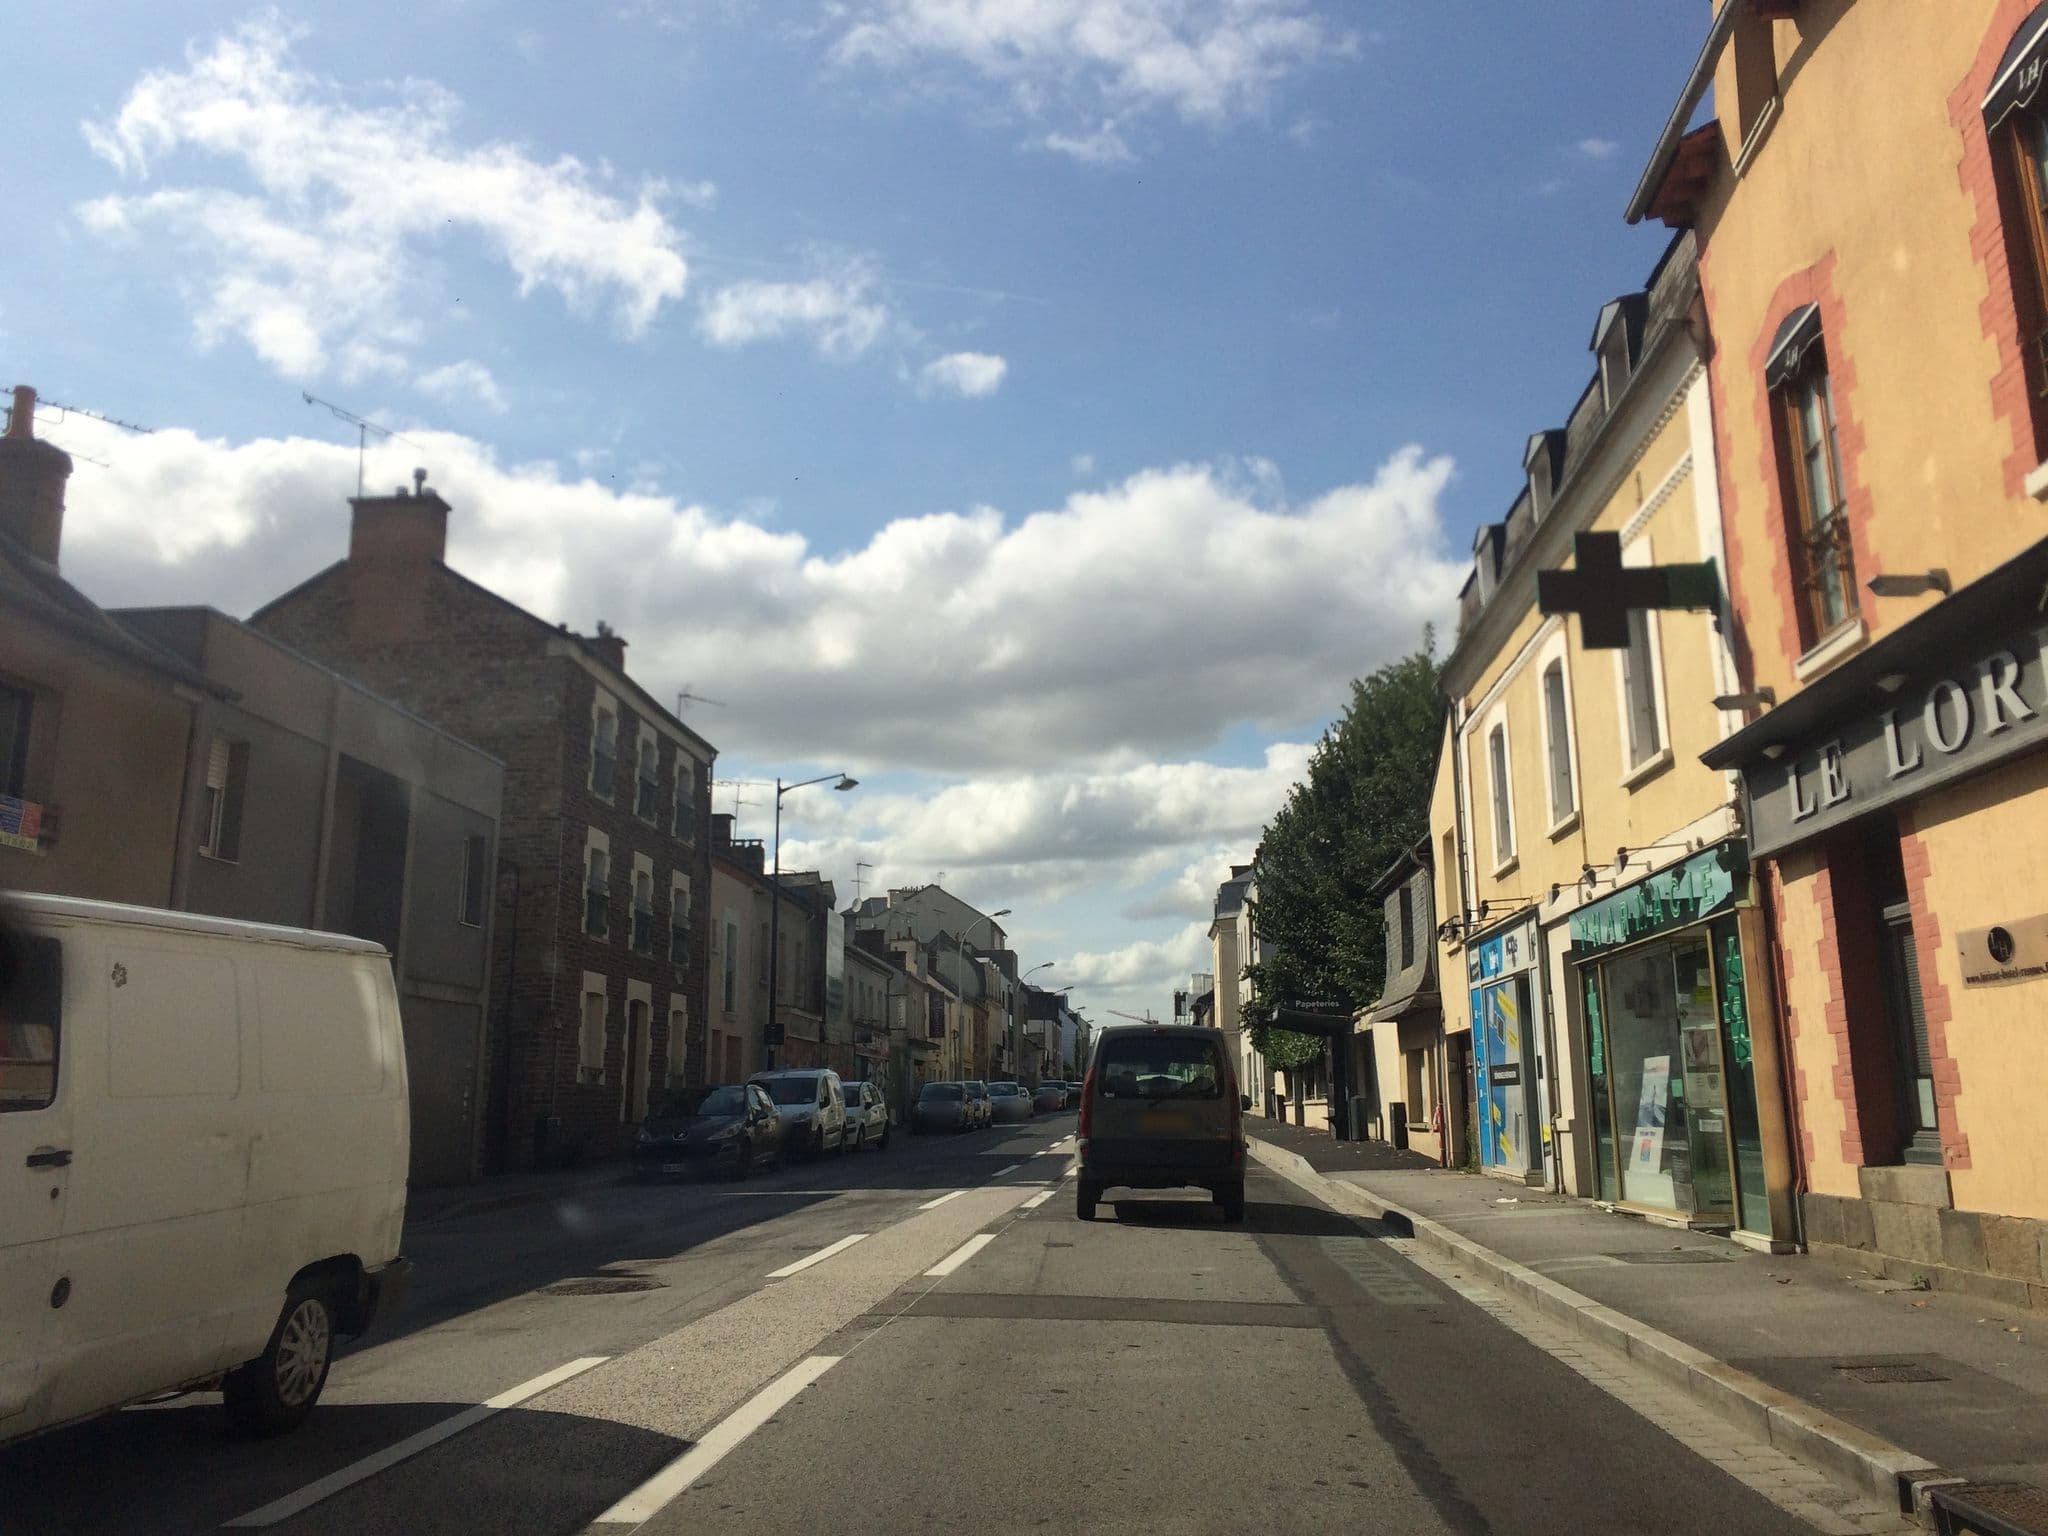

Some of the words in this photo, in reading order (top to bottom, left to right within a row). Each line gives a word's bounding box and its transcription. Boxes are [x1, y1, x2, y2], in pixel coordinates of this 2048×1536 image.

[1786, 739, 1852, 823] LE
[1580, 862, 1716, 951] PHARMACIE
[1295, 1000, 1340, 1009] Papeteries
